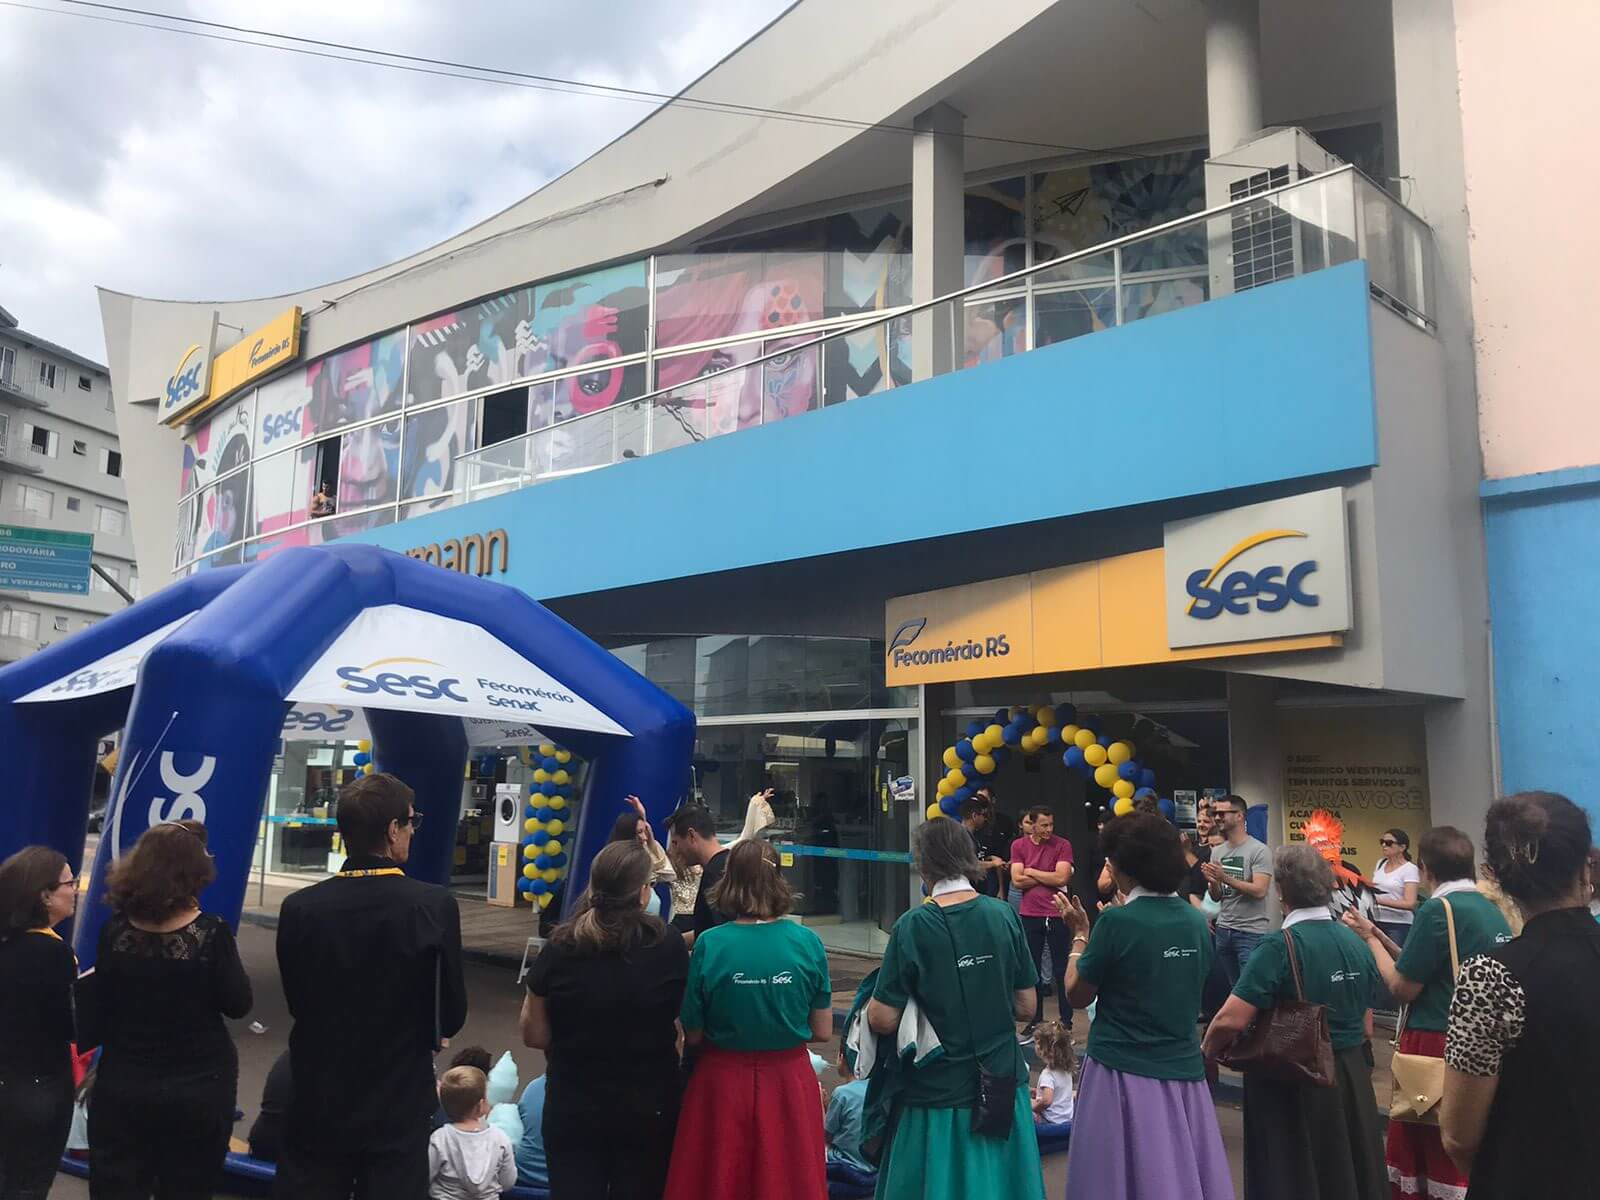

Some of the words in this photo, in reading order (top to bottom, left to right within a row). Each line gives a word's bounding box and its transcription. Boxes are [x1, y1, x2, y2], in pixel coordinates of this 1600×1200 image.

[893, 640, 983, 668] Fecomércio
[985, 633, 1010, 658] RS
[477, 677, 575, 704] Fecomércio
[486, 694, 542, 713] Senac
[1309, 778, 1349, 787] MUITOS
[1288, 789, 1352, 809] PARA
[1356, 786, 1425, 810] VOCÊ
